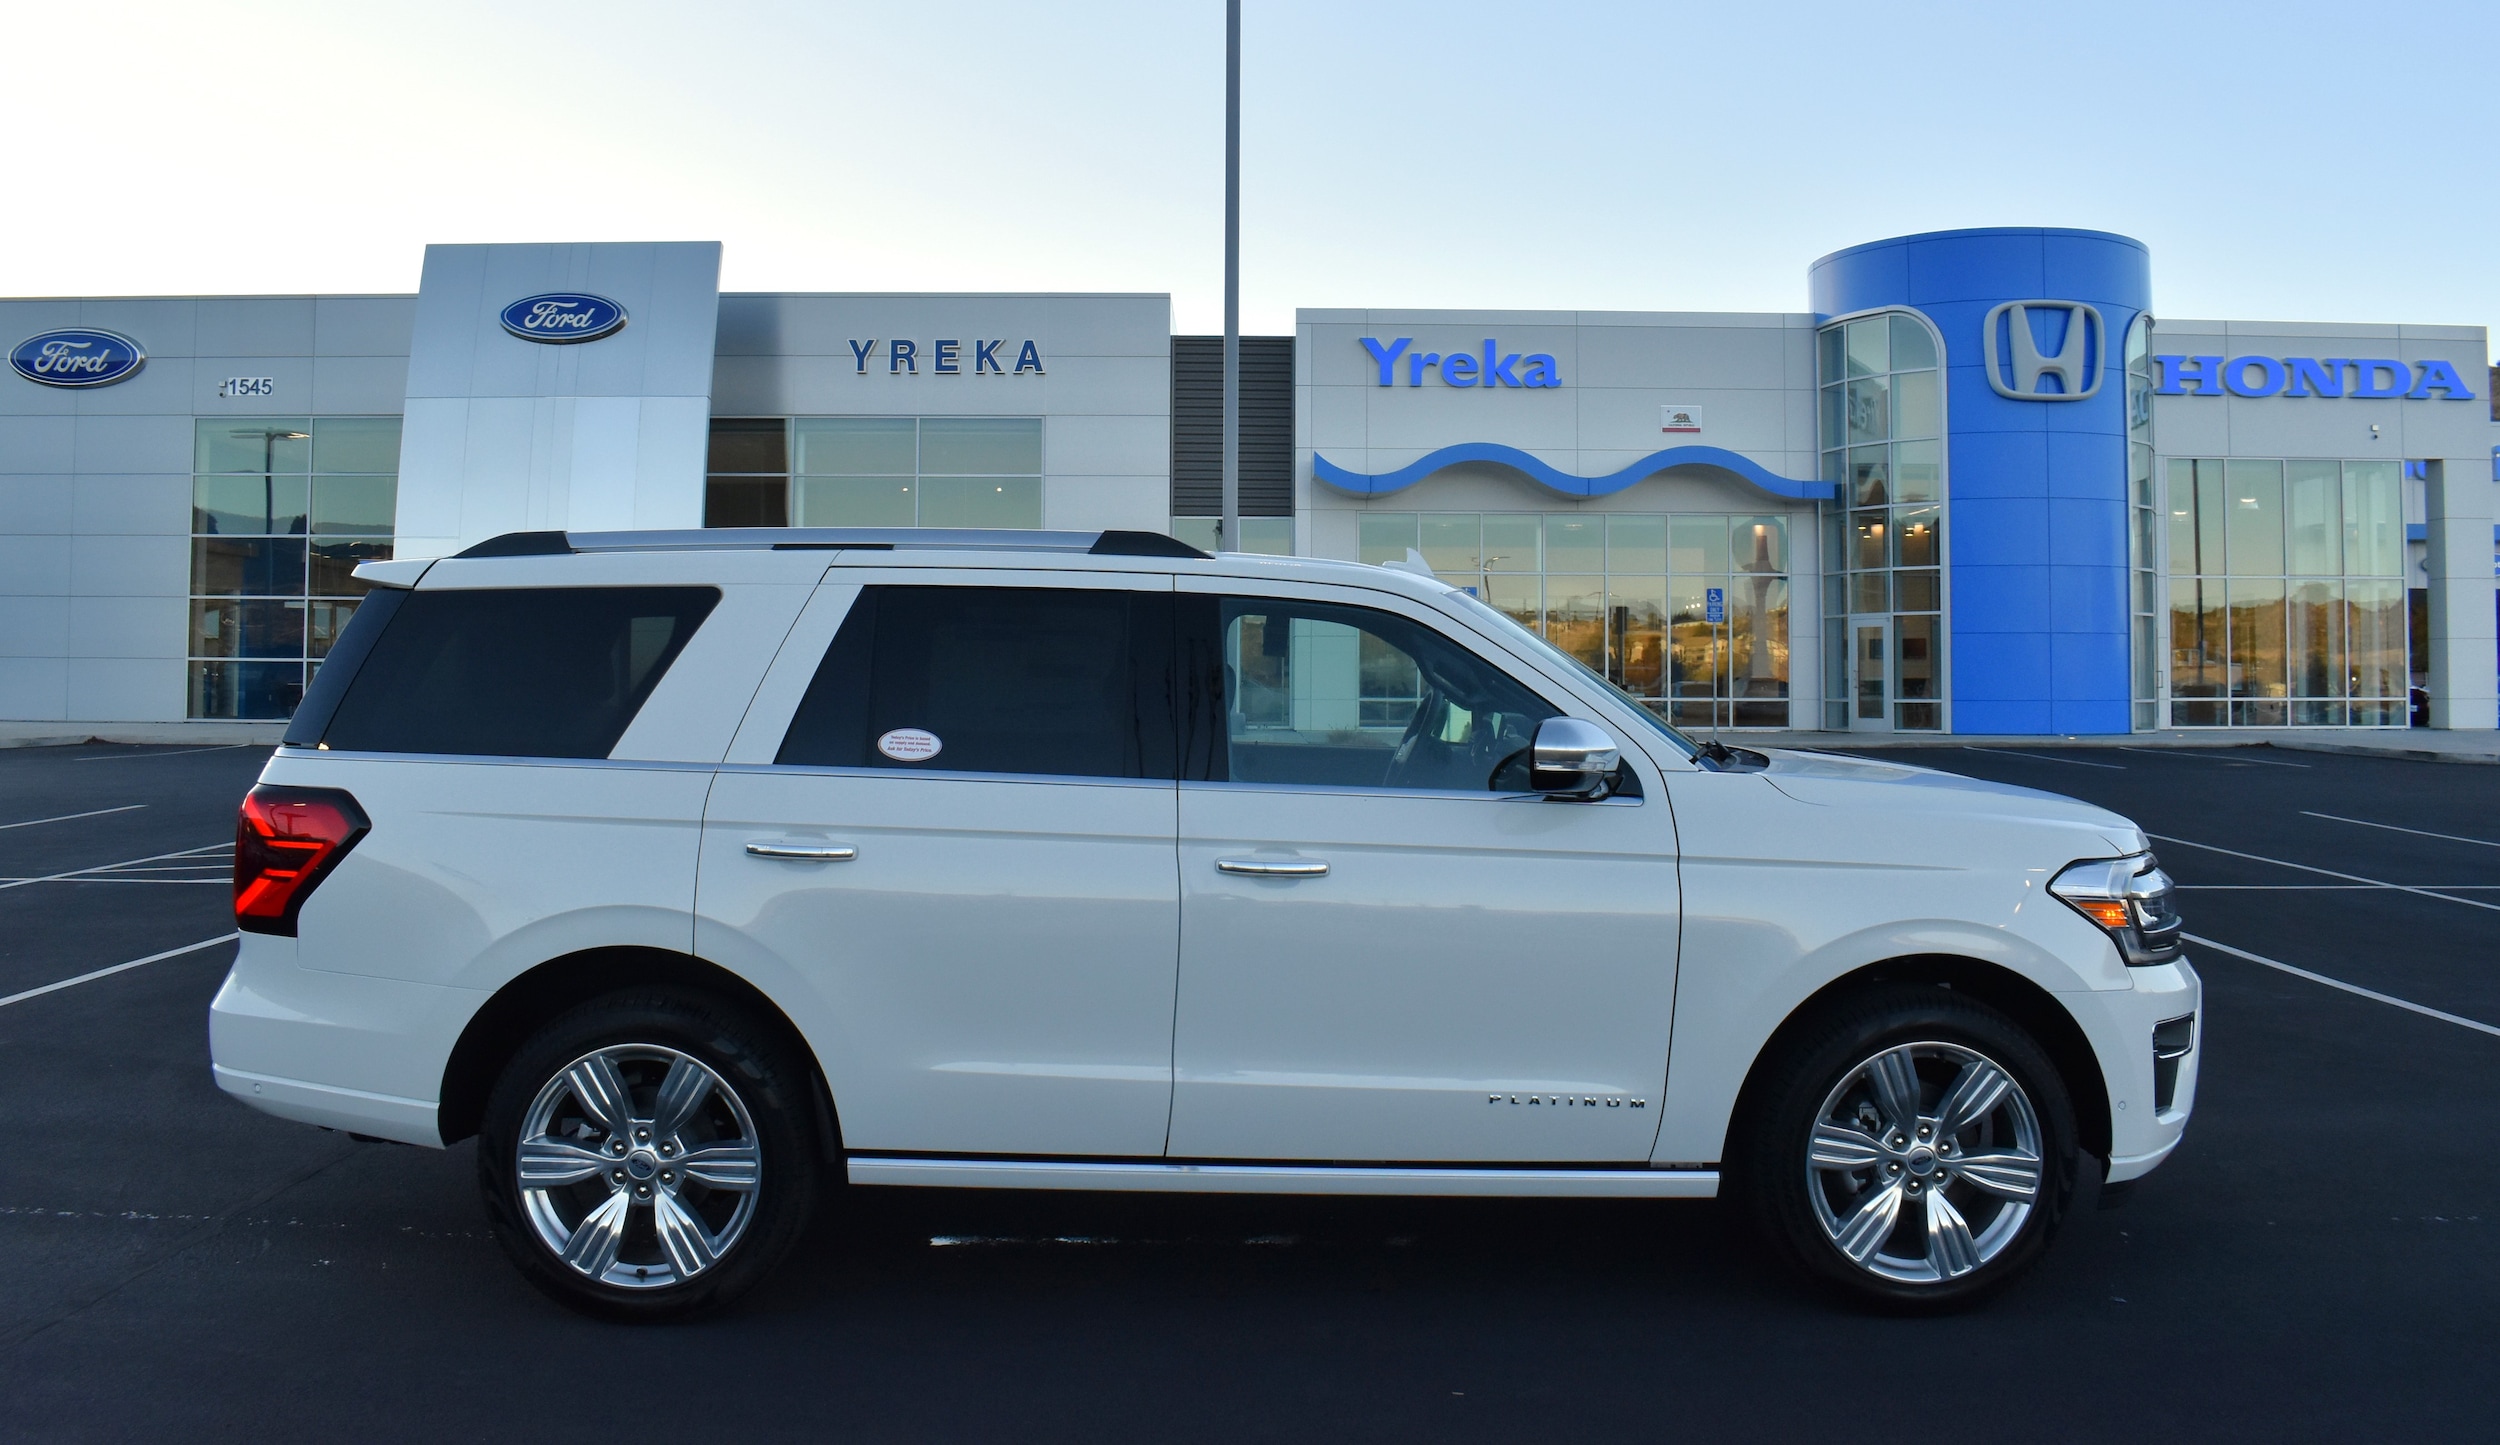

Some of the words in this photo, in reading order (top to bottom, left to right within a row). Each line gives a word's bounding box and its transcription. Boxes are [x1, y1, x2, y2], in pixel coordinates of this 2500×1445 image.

[524, 301, 596, 329] Ford
[34, 341, 111, 373] Ford
[847, 338, 1047, 375] YREKA
[1358, 337, 1563, 388] Yreka
[229, 378, 273, 396] 1545
[2153, 354, 2476, 400] HONDA
[1488, 1094, 1646, 1109] PLATINUM
